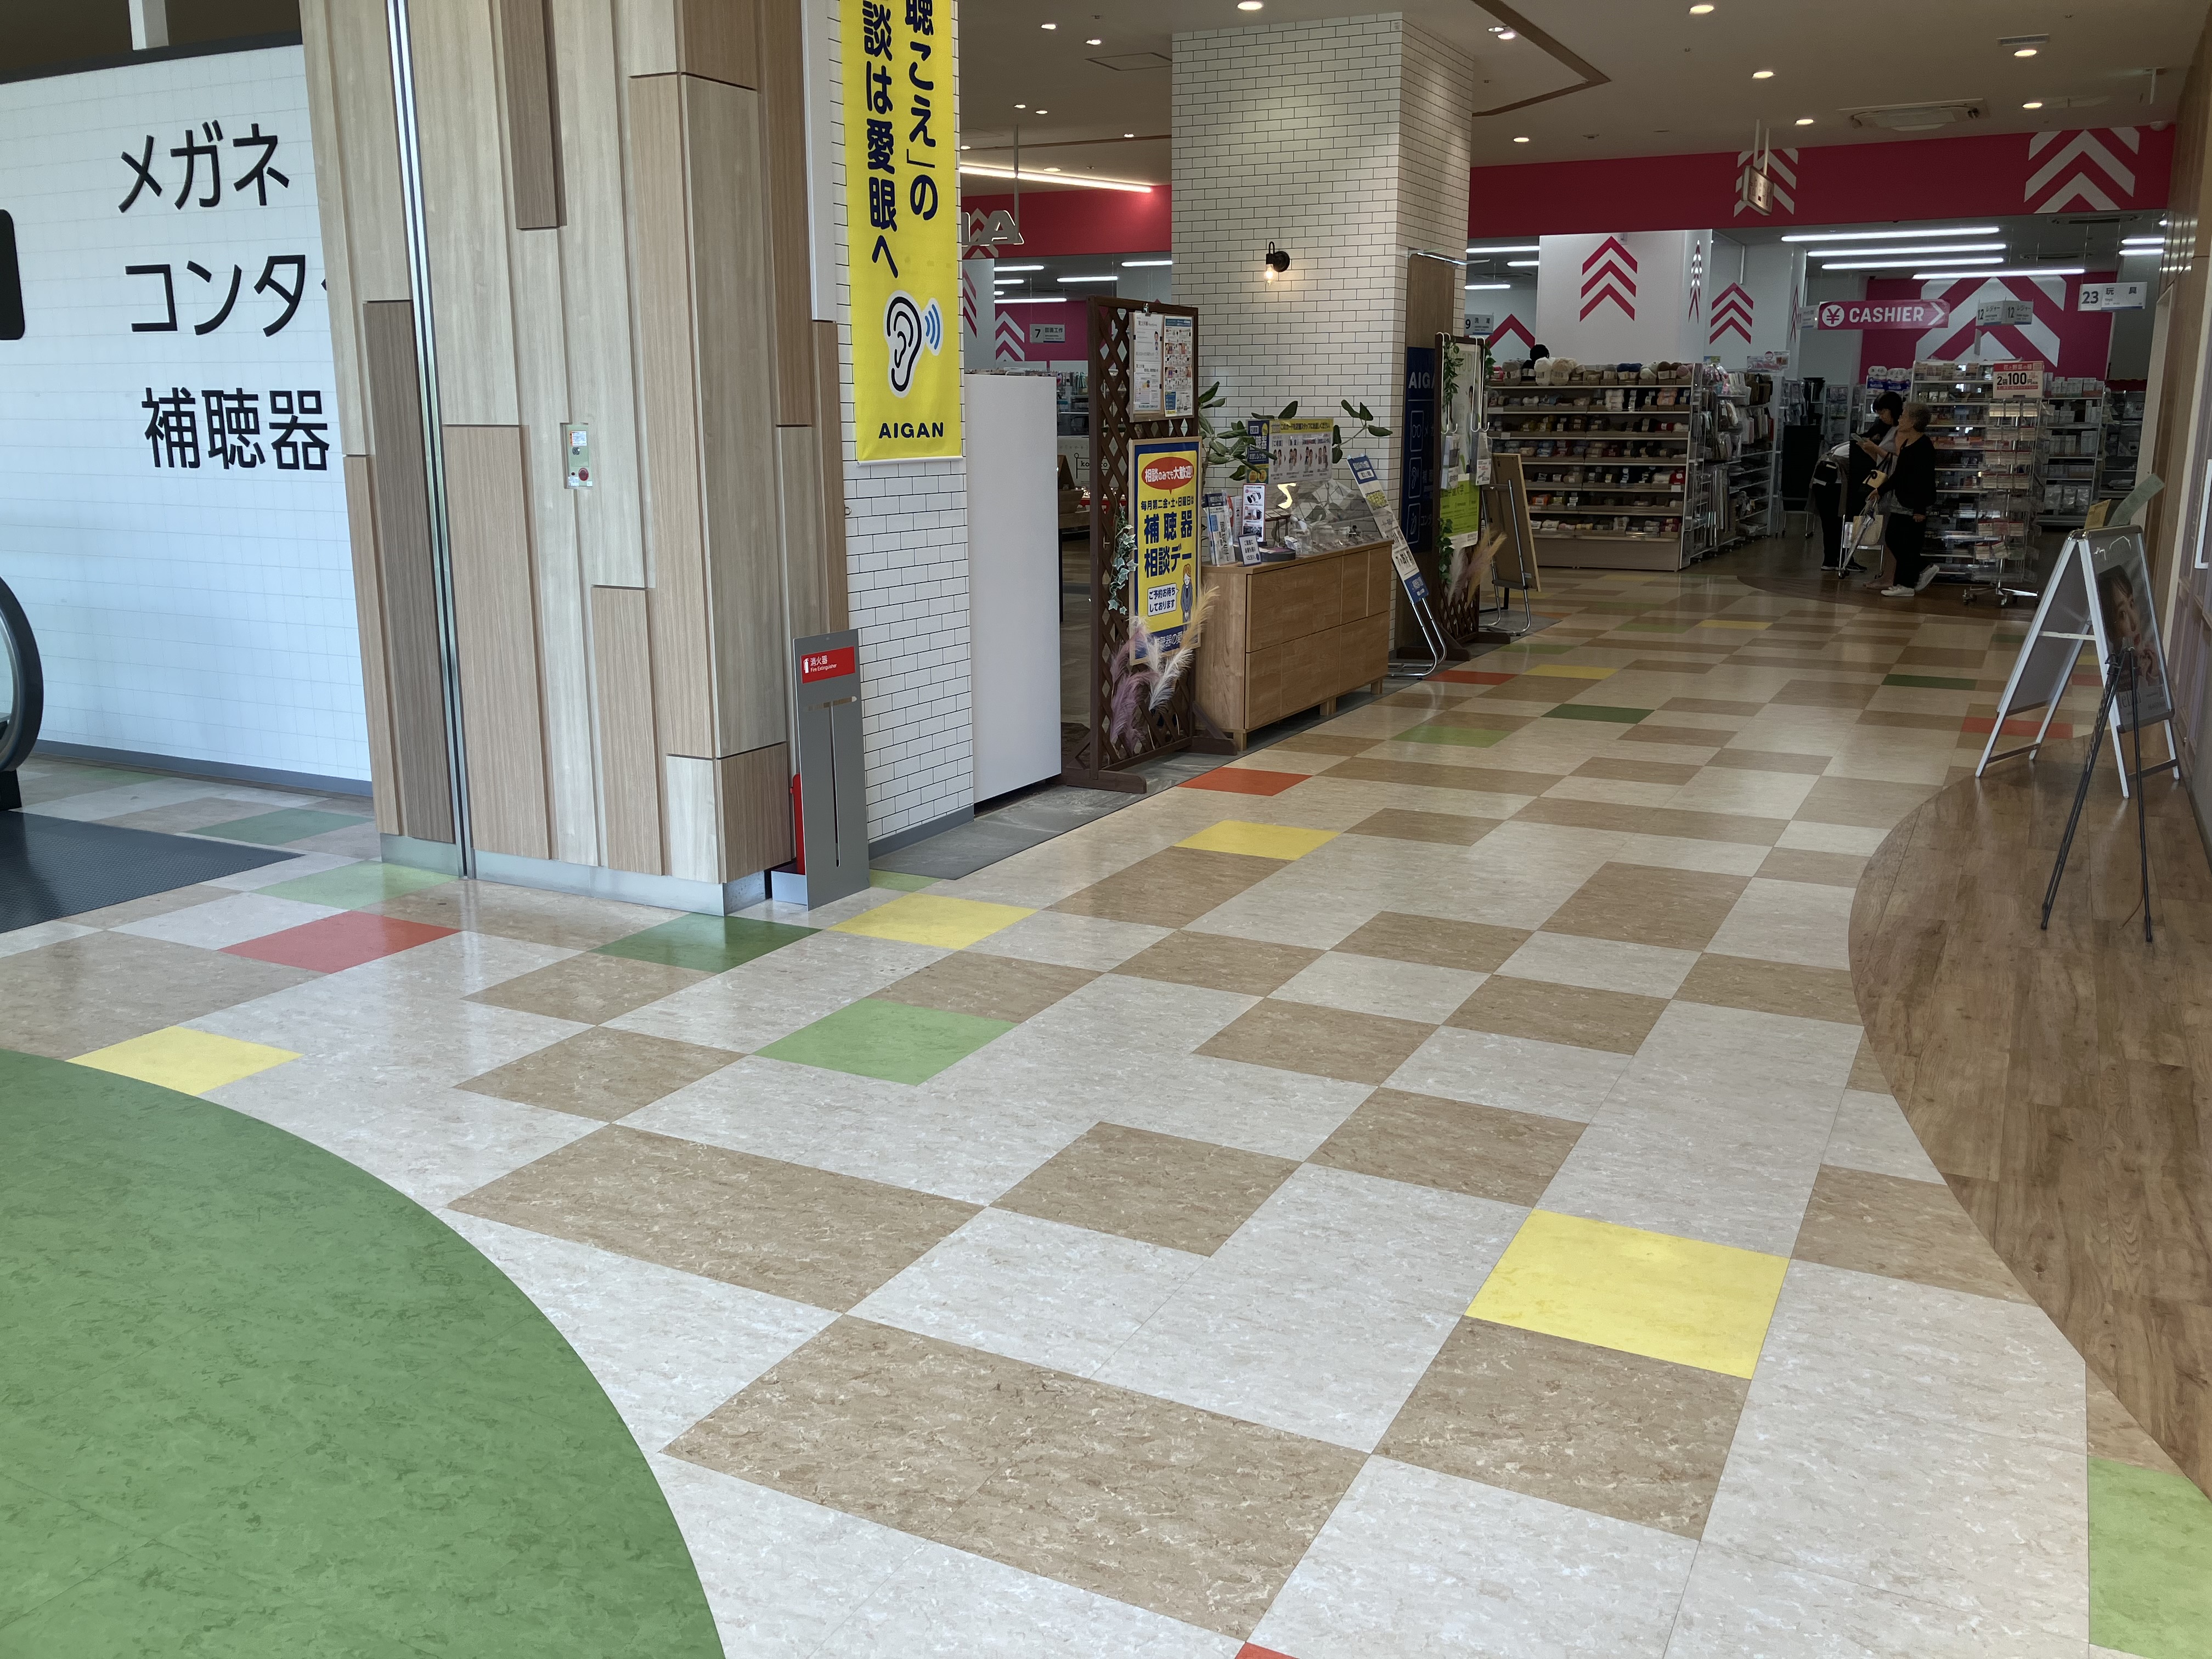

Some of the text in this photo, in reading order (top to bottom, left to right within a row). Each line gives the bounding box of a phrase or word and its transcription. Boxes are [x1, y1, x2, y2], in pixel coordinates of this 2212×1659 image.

[118, 120, 289, 213] メガネ
[125, 254, 328, 337] コンタ
[2081, 291, 2099, 304] 23
[1849, 307, 1925, 323] CASHIER
[1978, 309, 1984, 320] 12
[2007, 307, 2015, 318] 12
[1465, 319, 1471, 329] 9
[1035, 329, 1041, 338] 7
[141, 387, 330, 470] 補聴器
[878, 422, 944, 439] AIGAN
[1144, 465, 1193, 483] 相談のみでも大歓迎!
[1141, 495, 1194, 511] 毎月第二金・土・日曜日は
[1144, 510, 1193, 545] 補聴器
[1144, 543, 1192, 578] 相談デー
[1149, 586, 1175, 600] ご予約お待ち
[1149, 599, 1175, 613] しております
[810, 655, 828, 667] 消火器
